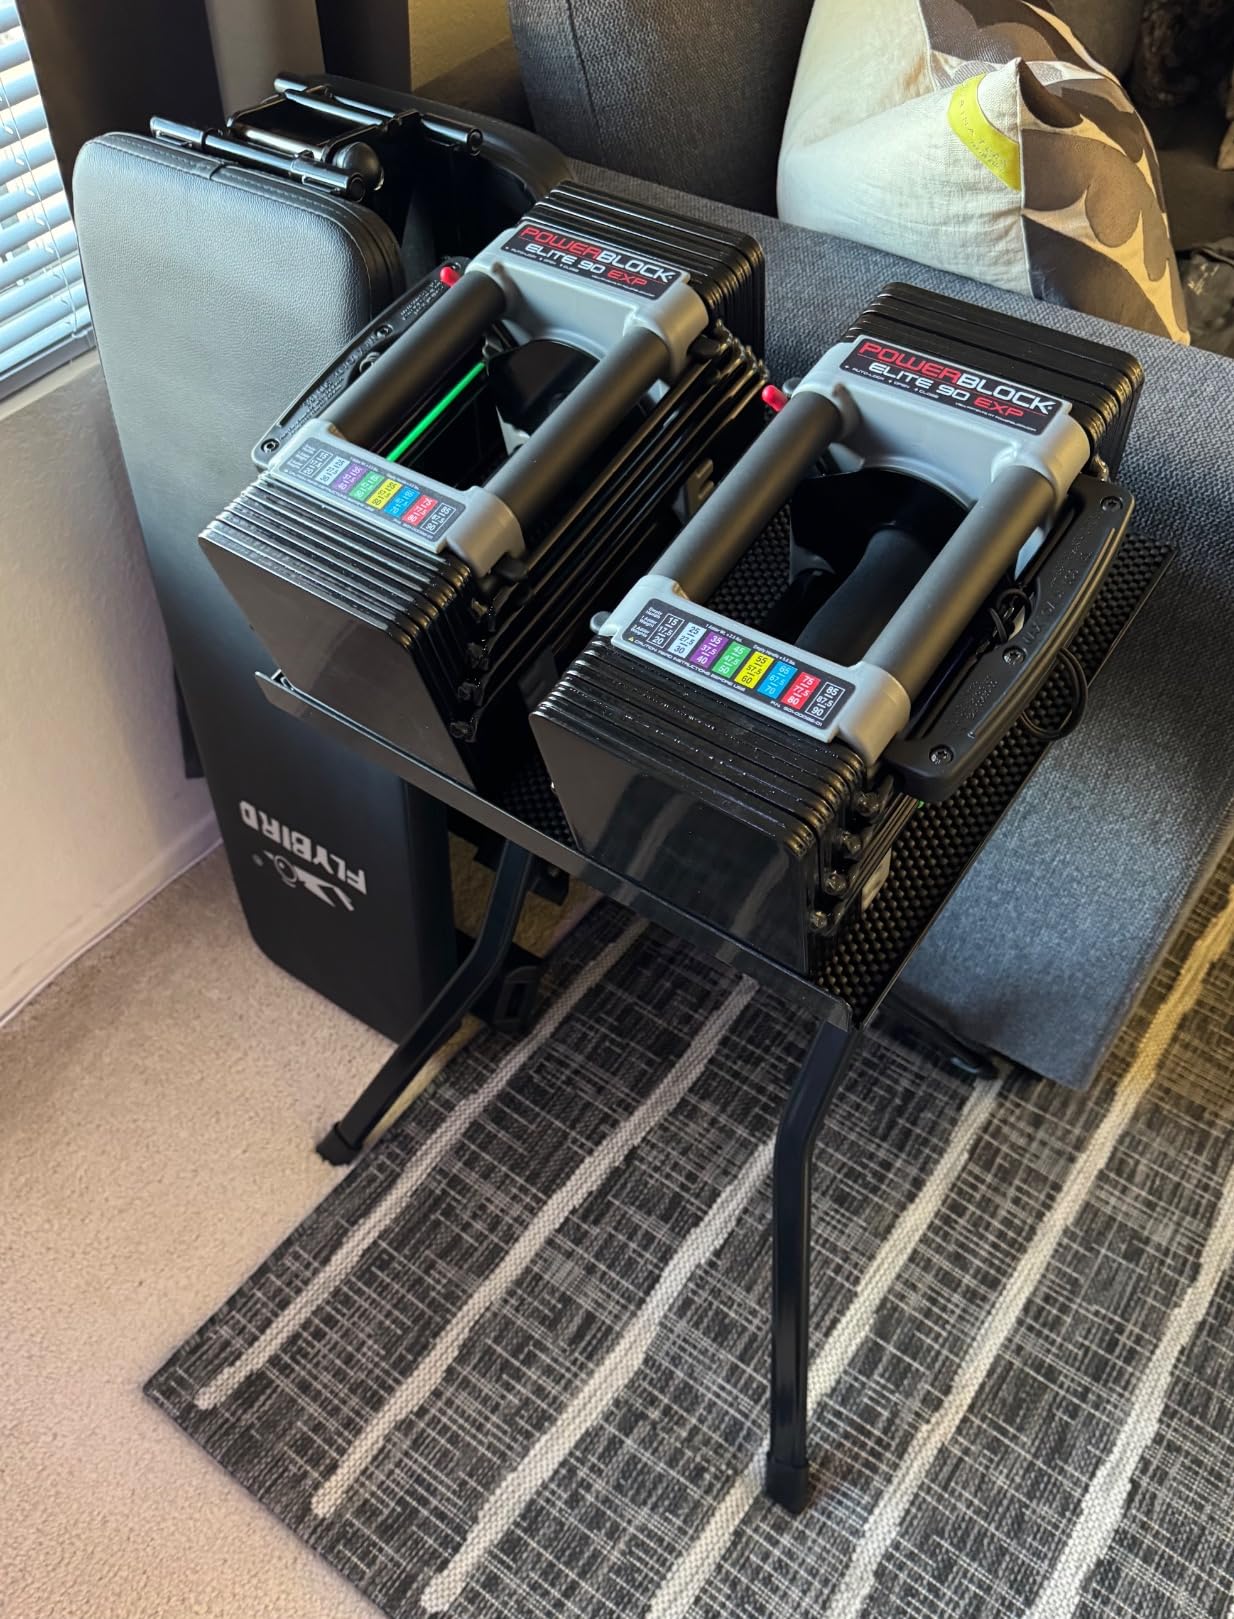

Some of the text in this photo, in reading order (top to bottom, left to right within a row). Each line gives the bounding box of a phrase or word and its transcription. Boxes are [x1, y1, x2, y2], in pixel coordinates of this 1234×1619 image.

[520, 227, 676, 283] POWERBLOCK
[525, 243, 578, 265] ELITE
[577, 260, 606, 274] 90
[607, 269, 648, 286] EXP
[859, 342, 1056, 415] POWERBLOCK
[868, 362, 1024, 417] ELITE 90 EXP
[667, 617, 679, 626] 15
[658, 626, 673, 636] 17.5
[688, 626, 701, 635] 25
[652, 635, 664, 645] 20
[679, 635, 695, 646] 27.5
[710, 635, 723, 644] 35
[673, 645, 686, 654] 30
[701, 644, 717, 655] 37.5
[733, 646, 745, 655] 45
[696, 655, 708, 665] 40
[723, 655, 739, 665] 47.5
[755, 655, 768, 664] 55
[718, 665, 730, 674] 50
[746, 664, 762, 675] 57.5
[779, 665, 791, 675] 65
[741, 675, 753, 684] 60
[769, 675, 785, 686] 67.5
[802, 675, 814, 686] 75
[764, 685, 776, 695] 70
[793, 685, 810, 697] 77.5
[826, 686, 839, 696] 85
[787, 695, 800, 705] 80
[816, 695, 834, 707] 87.5
[811, 706, 824, 717] 90
[239, 800, 367, 895] FLYBIRD
